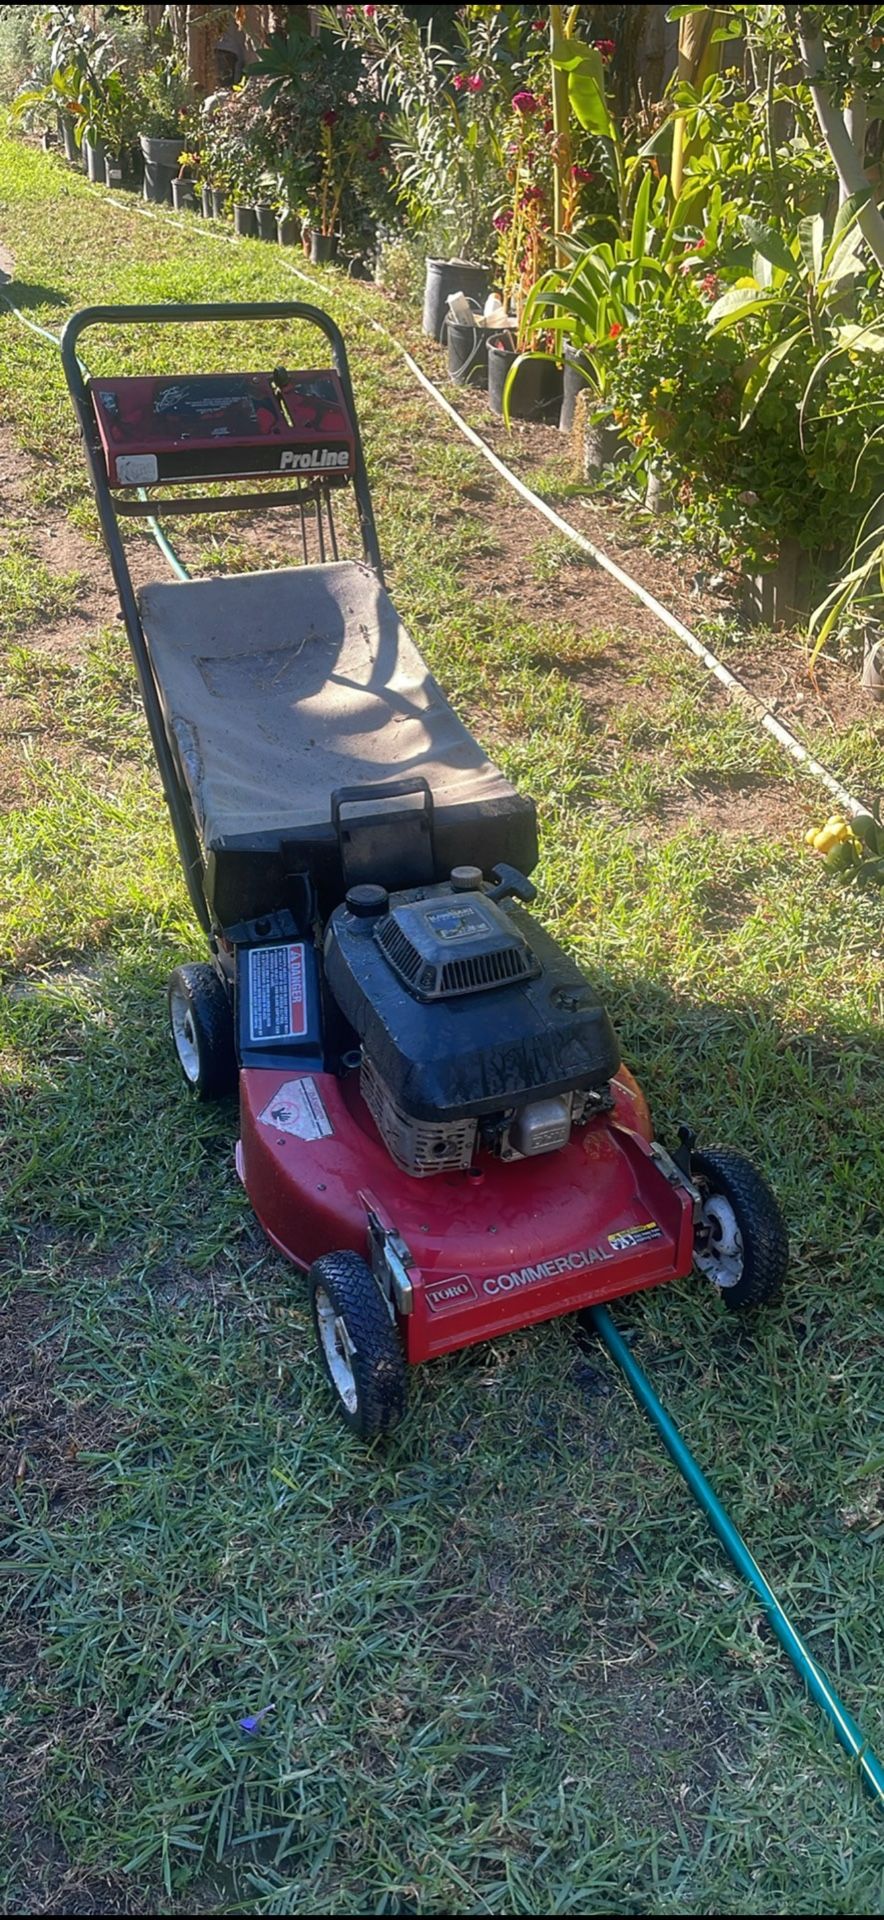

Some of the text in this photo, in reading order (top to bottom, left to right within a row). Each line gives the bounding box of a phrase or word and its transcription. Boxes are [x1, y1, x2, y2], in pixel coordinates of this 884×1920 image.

[280, 450, 349, 469] ProLine
[291, 963, 302, 1004] DANGER
[483, 1246, 614, 1295] COMMERCIAL
[429, 1284, 468, 1303] TORO
